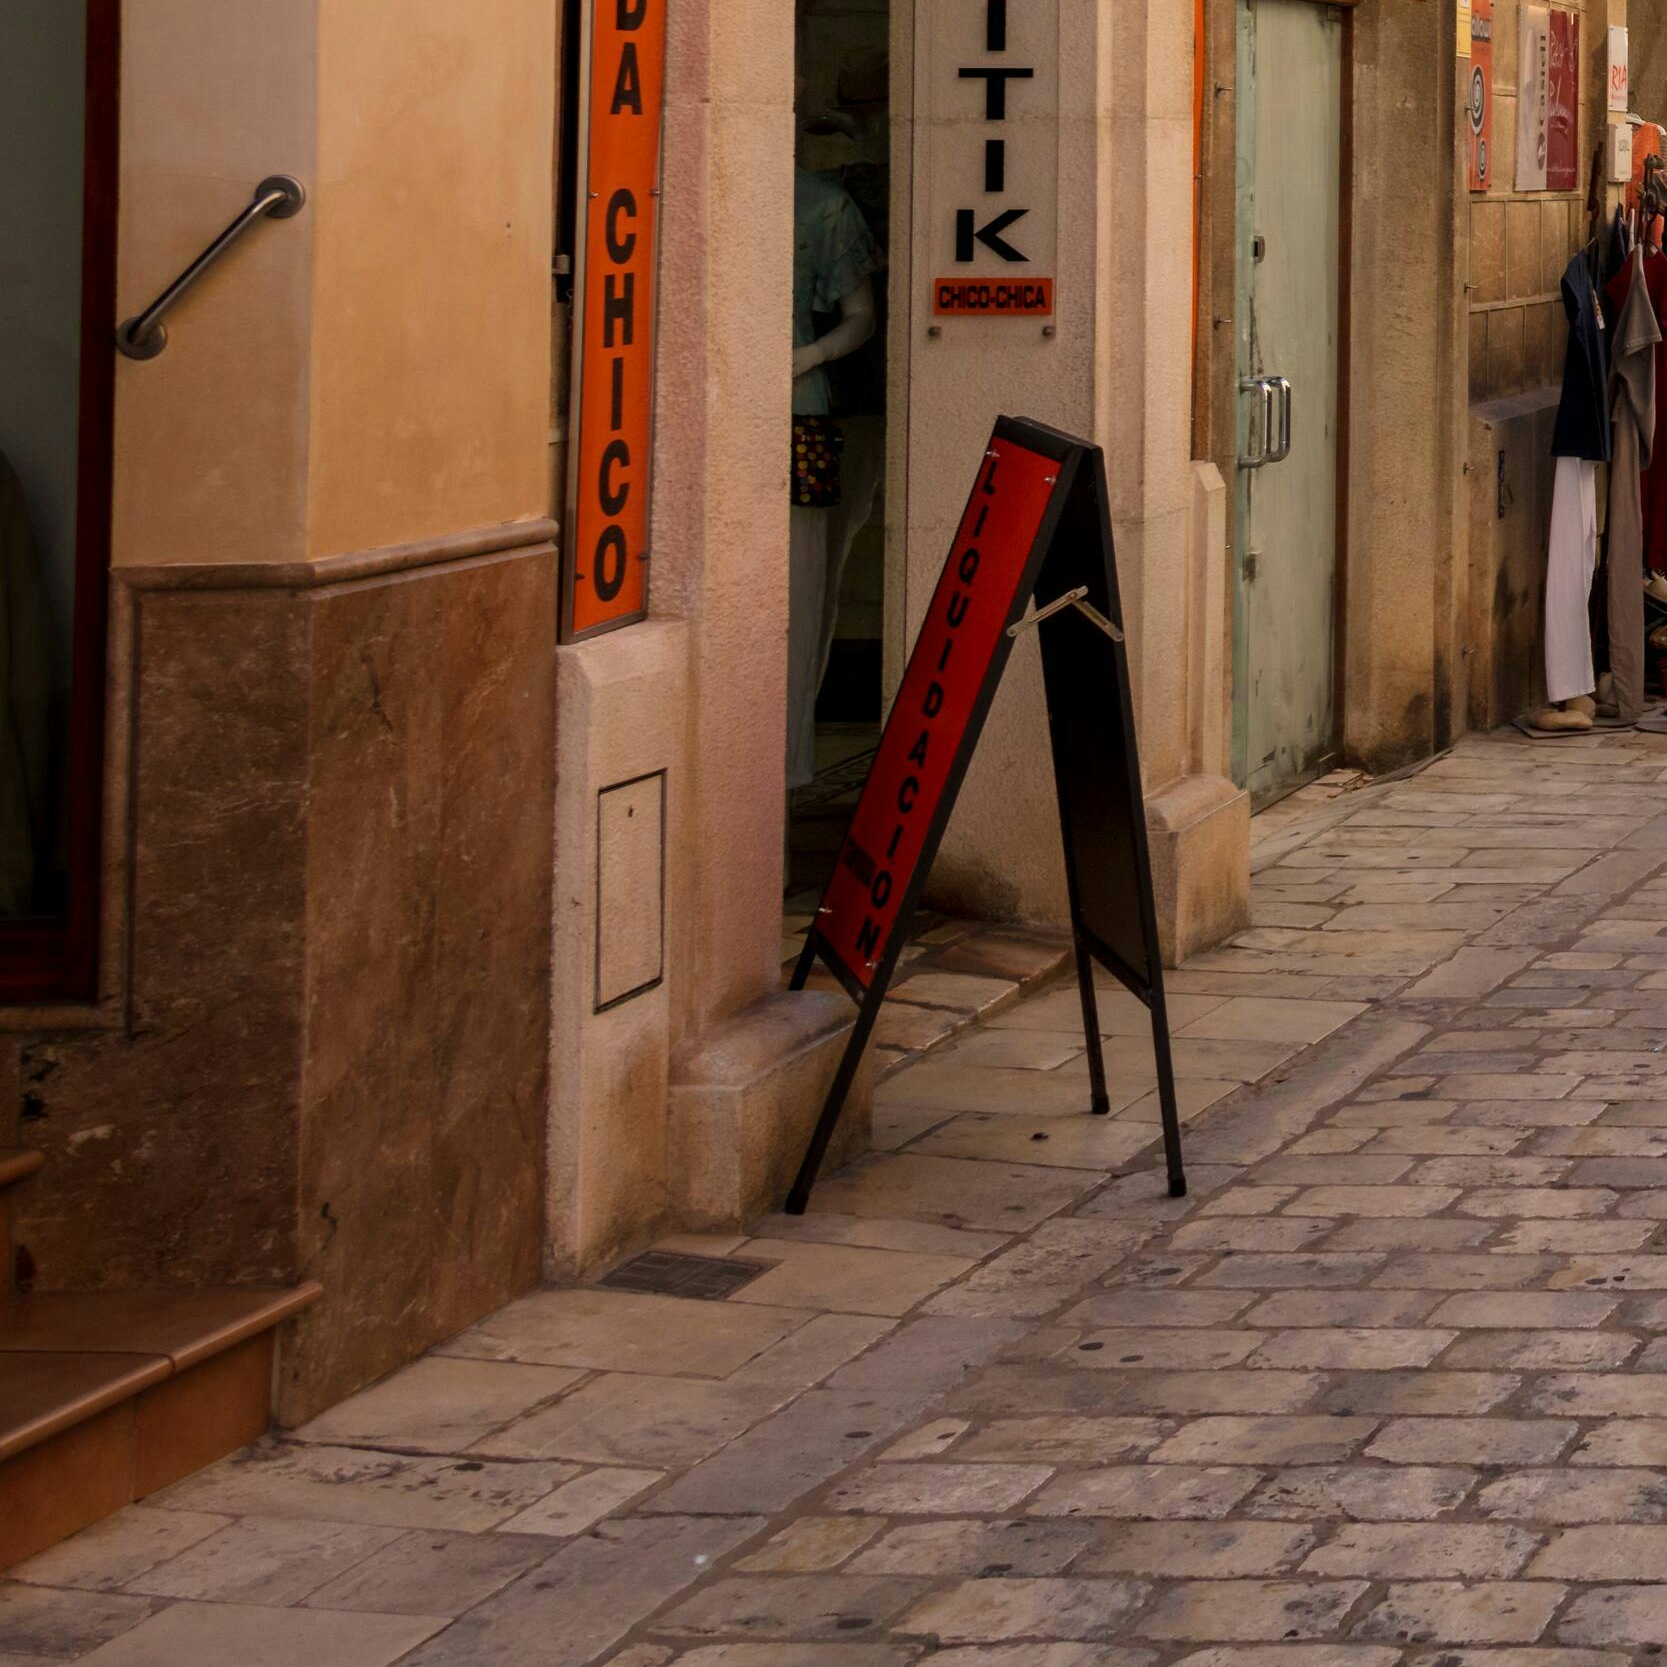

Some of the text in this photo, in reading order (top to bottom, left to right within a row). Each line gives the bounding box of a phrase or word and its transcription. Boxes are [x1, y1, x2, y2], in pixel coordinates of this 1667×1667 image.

[1611, 64, 1627, 91] RIA
[592, 187, 638, 603] CHICO
[939, 285, 1046, 309] CHICO-CHICA
[854, 459, 999, 960] LIQUIDACION
